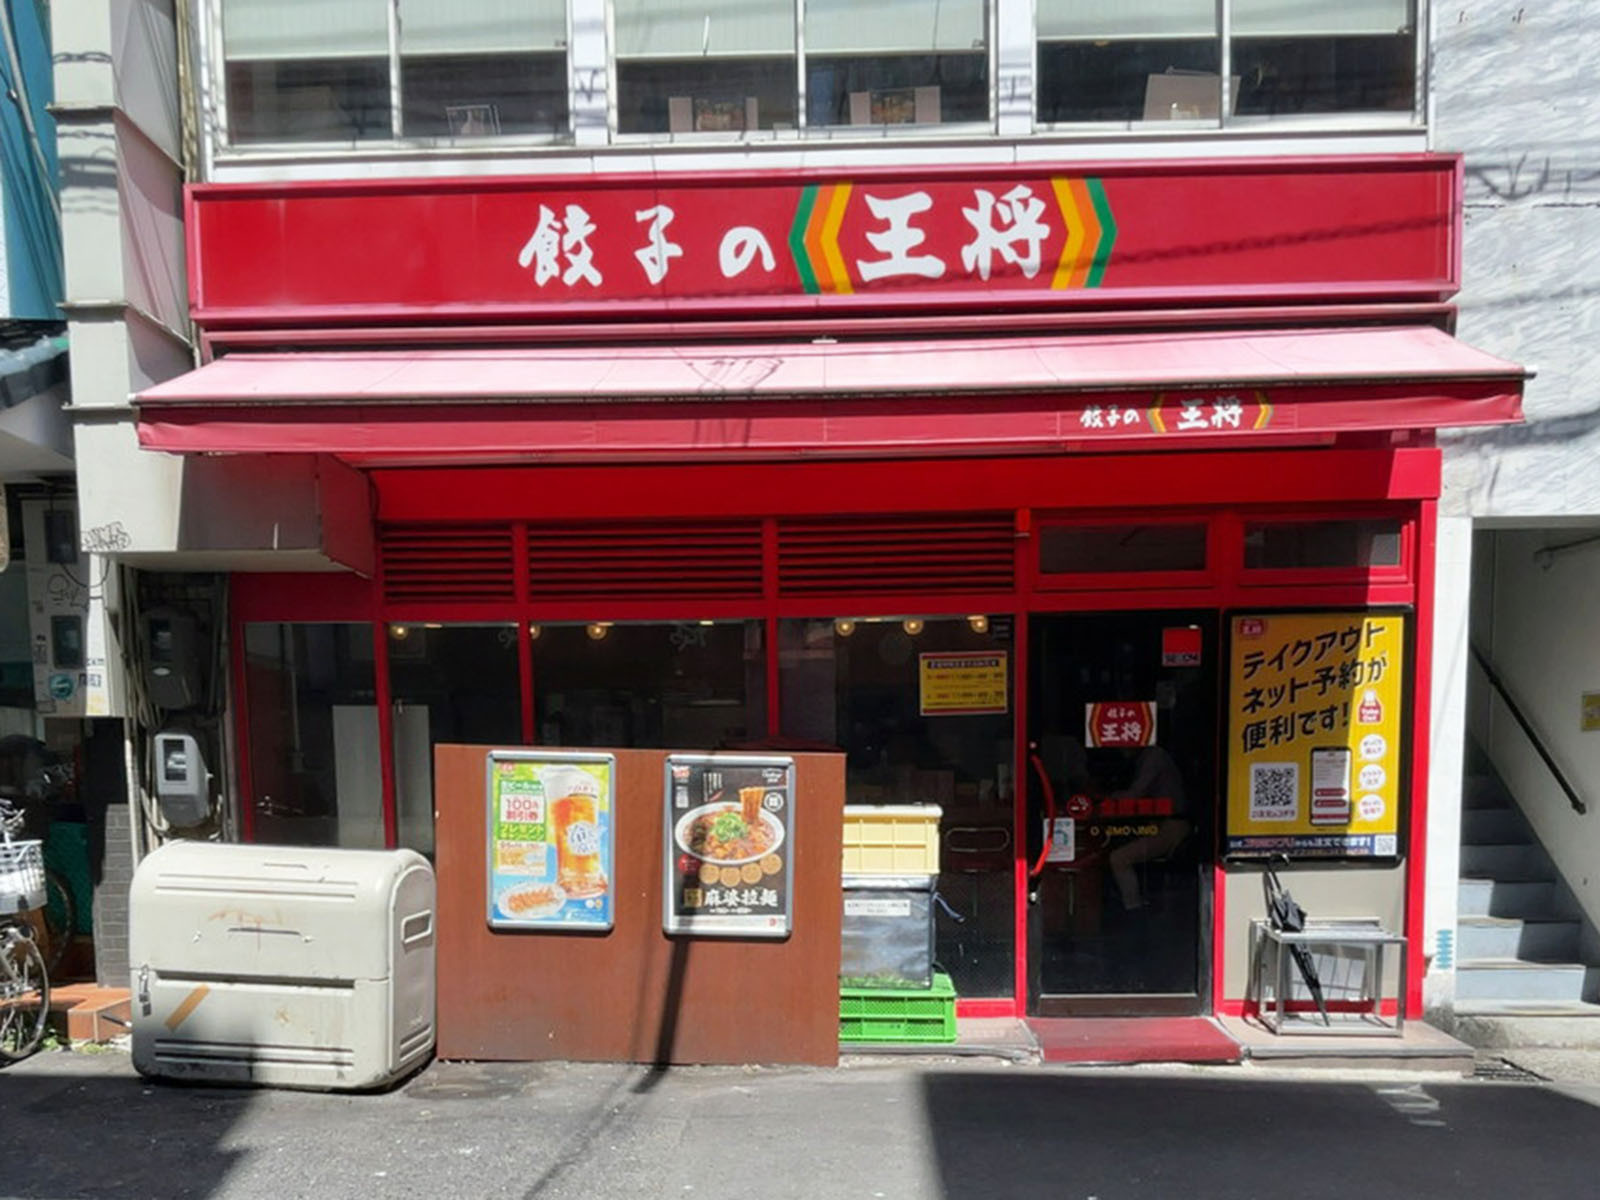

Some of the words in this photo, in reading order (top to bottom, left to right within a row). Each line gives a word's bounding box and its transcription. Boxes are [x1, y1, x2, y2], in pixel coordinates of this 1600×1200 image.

[518, 203, 776, 287] 餃子の
[856, 184, 1051, 282] 王将
[1080, 405, 1140, 428] 餃子の
[1177, 395, 1243, 430] 王将
[1243, 621, 1386, 680] テイクアウト
[1241, 657, 1387, 716] ネット予約が
[1101, 722, 1142, 742] 王将
[1107, 708, 1136, 719] 餃子の
[1241, 702, 1350, 754] 便利です!
